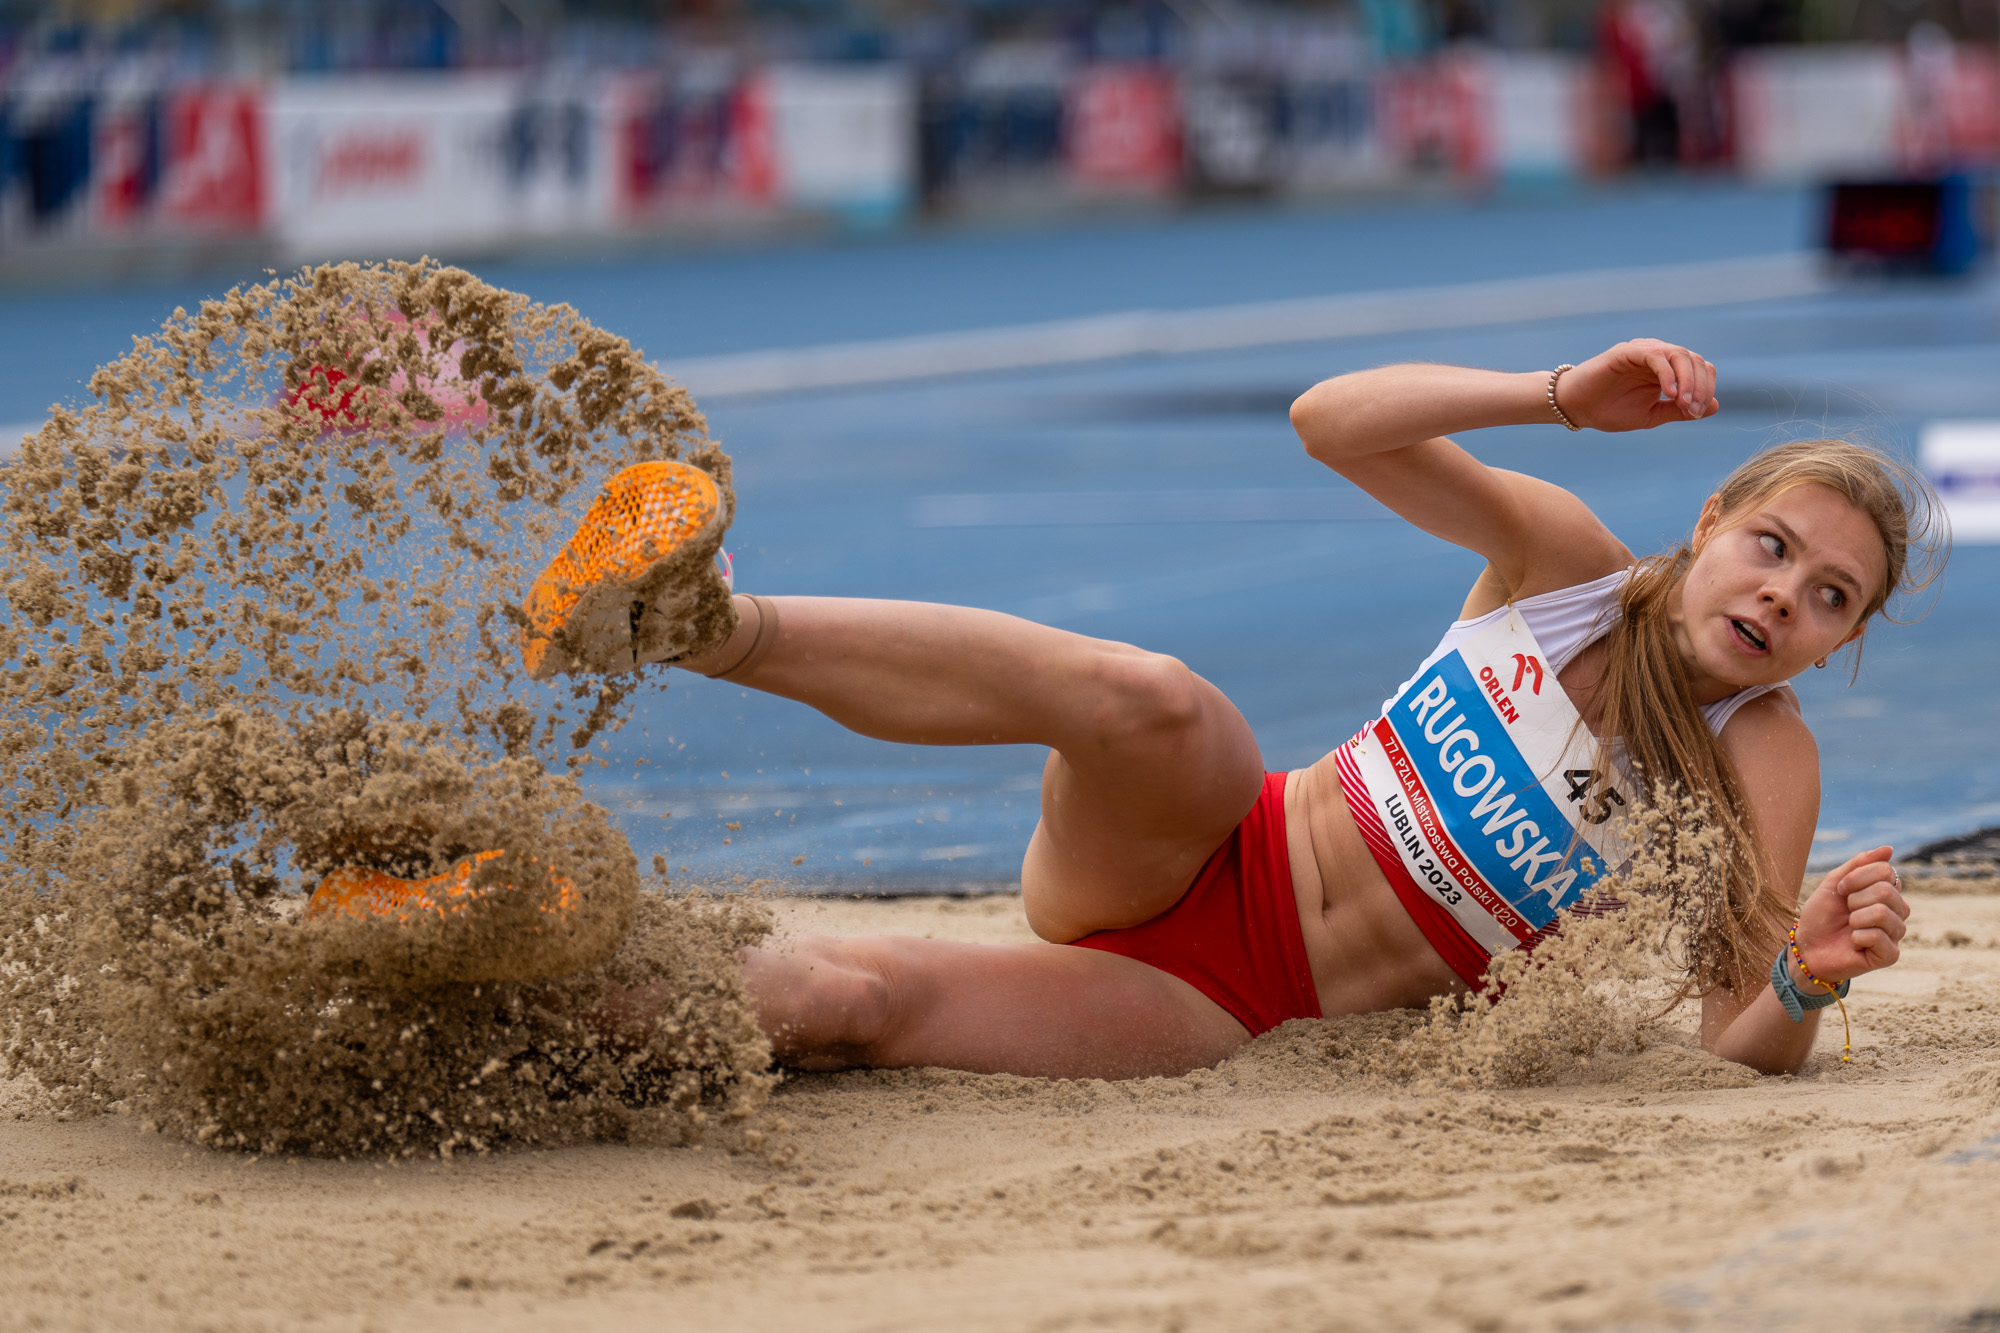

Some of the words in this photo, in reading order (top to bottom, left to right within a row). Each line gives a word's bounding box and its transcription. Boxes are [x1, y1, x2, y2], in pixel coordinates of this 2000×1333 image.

[1479, 666, 1520, 725] ORLEN
[1384, 736, 1400, 760] 77.
[1395, 757, 1416, 791] PZLA
[1409, 789, 1460, 869] Mistrzostwa
[1456, 867, 1494, 906] Polski
[1491, 904, 1518, 928] U20
[1408, 674, 1578, 910] RUGOWSKA
[1563, 768, 1626, 825] 45
[1384, 793, 1424, 861] LUBLIN
[1418, 859, 1462, 905] 2023
